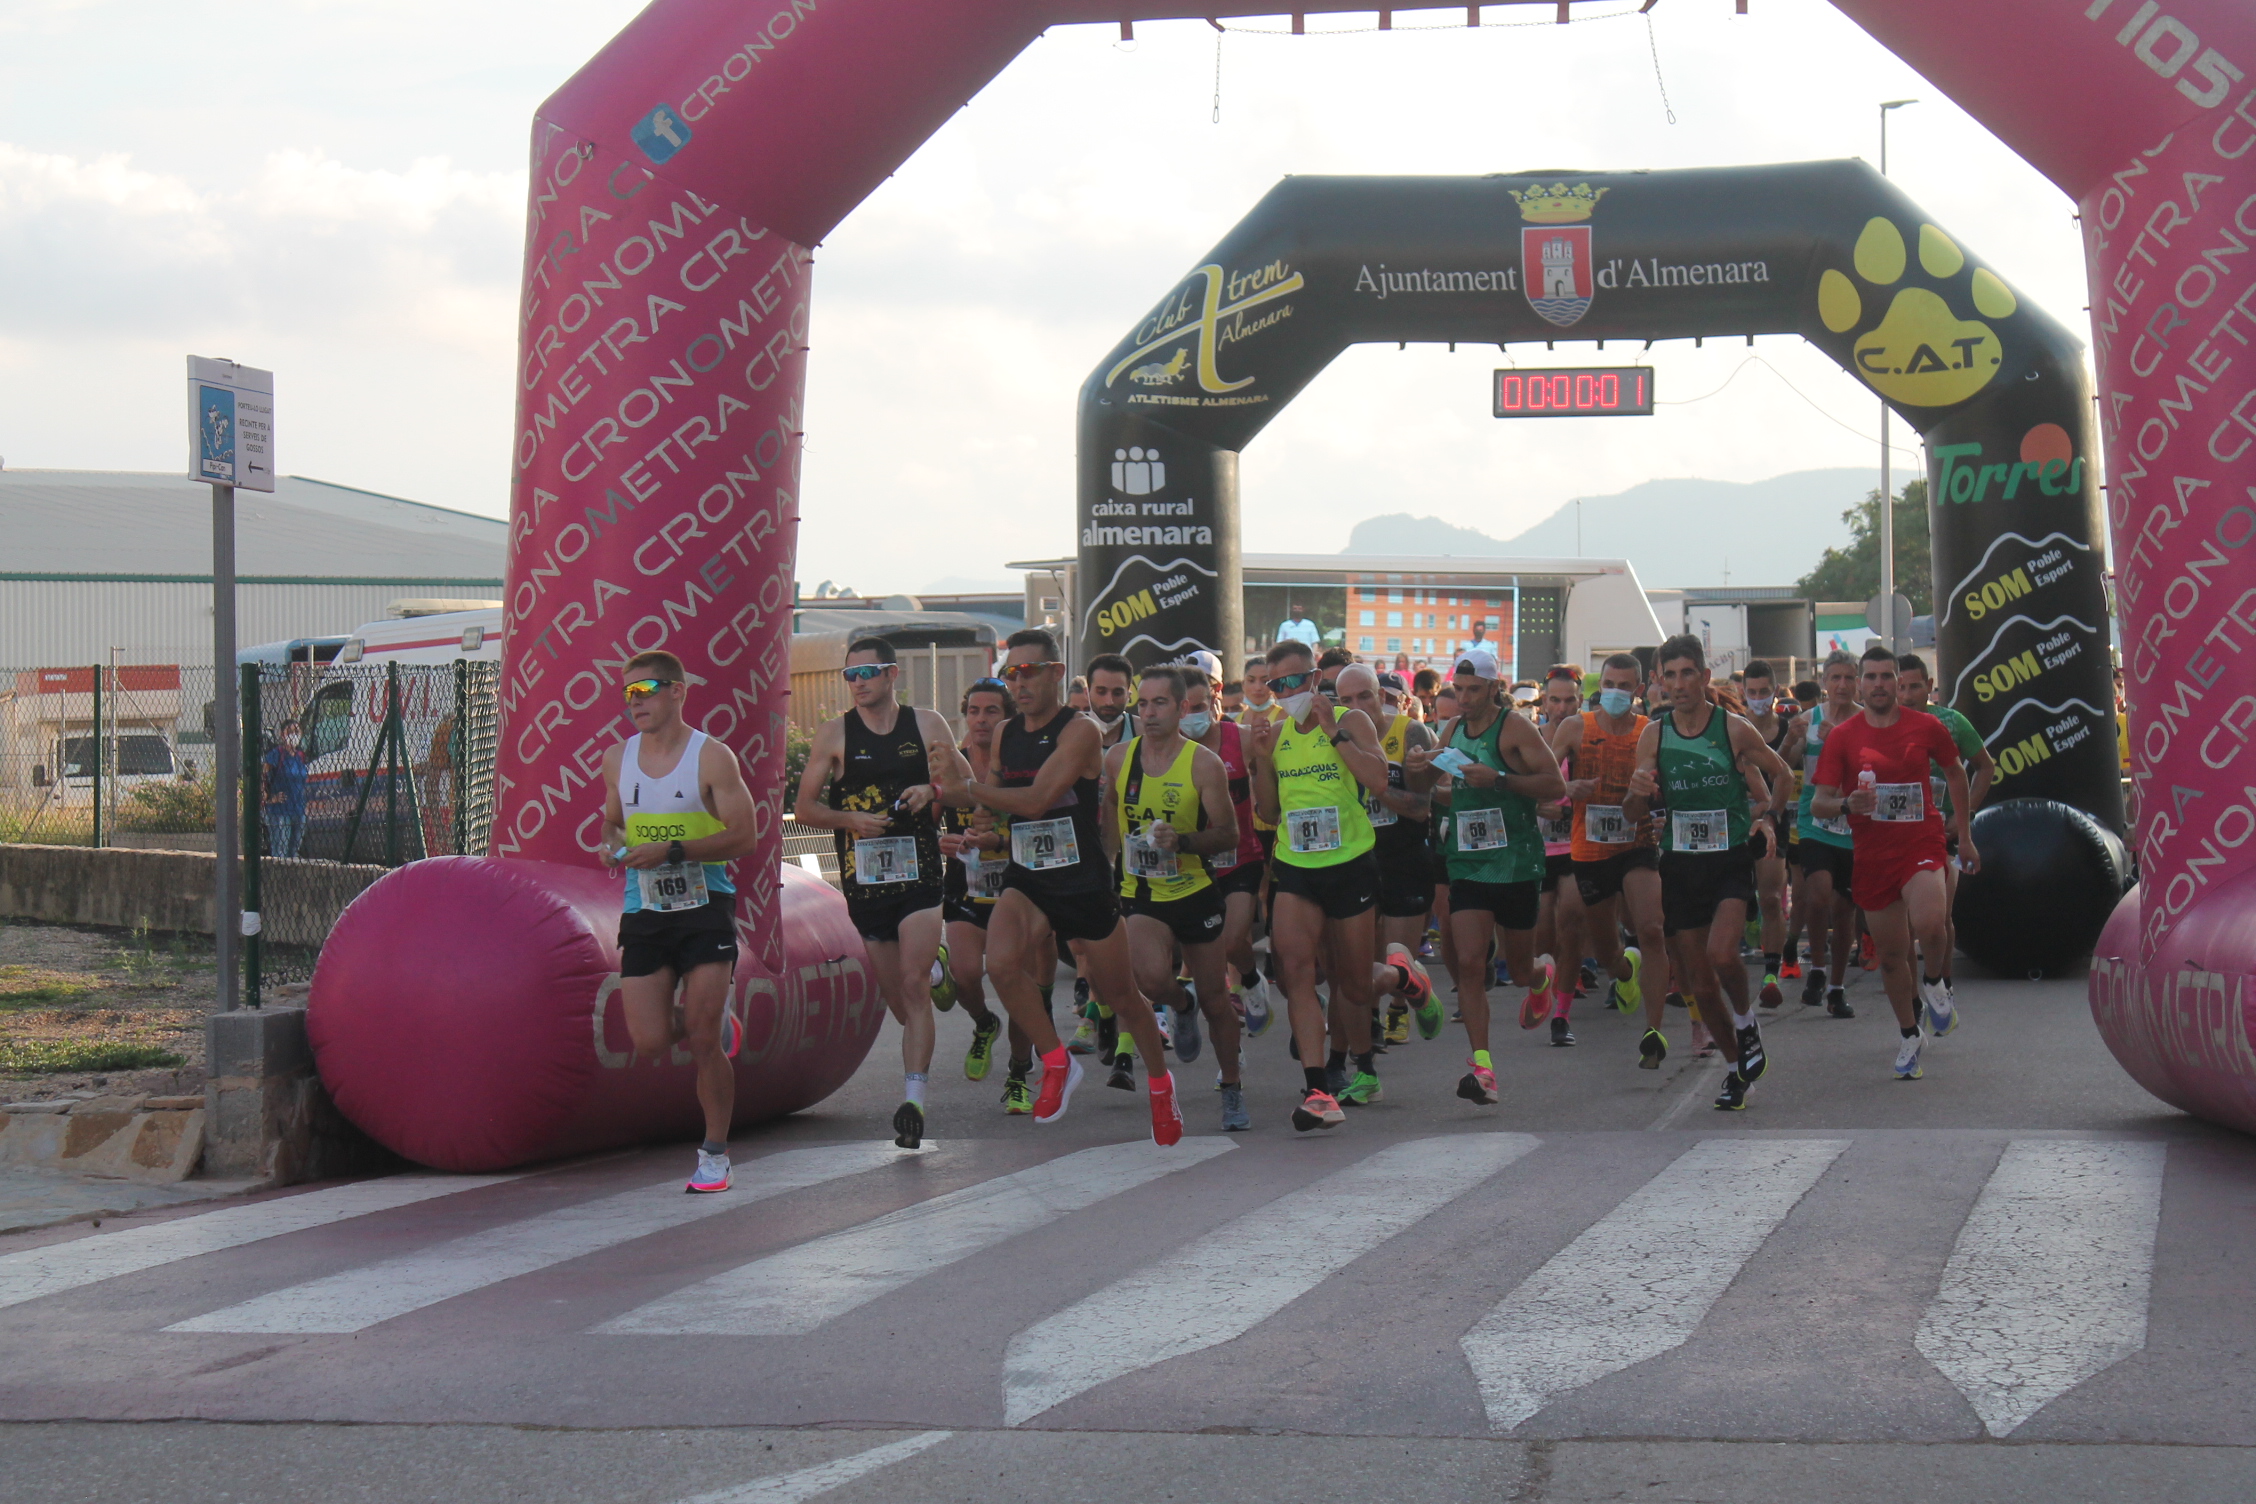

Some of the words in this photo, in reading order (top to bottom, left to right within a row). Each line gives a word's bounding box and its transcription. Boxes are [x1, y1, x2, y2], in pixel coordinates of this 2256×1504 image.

[1354, 264, 1517, 299] Ajuntament
[1596, 259, 1769, 290] d'Almenara
[1135, 286, 1192, 345] Club
[1218, 304, 1293, 351] Almenara
[1127, 394, 1199, 406] ATLETISME
[1202, 394, 1269, 406] ALMENARA
[1933, 442, 2085, 505] Torres
[1091, 498, 1136, 516] caixa
[1142, 498, 1194, 516] rural
[1082, 520, 1212, 547] almenara
[2027, 548, 2062, 573] Poble
[1152, 572, 1188, 595] Poble
[1964, 566, 2032, 620] SOM
[2034, 560, 2074, 587] Esport
[1097, 588, 1158, 637] SOM
[1159, 584, 1199, 609] Esport
[2036, 630, 2070, 655] Poble
[1973, 649, 2042, 702] SOM
[2043, 642, 2082, 670] Esport
[2046, 713, 2080, 739] Poble
[2053, 725, 2091, 753] Esport
[1889, 795, 1907, 809] 32
[636, 824, 686, 841] saggas
[1302, 821, 1319, 838] 81
[1469, 822, 1487, 837] 58
[1601, 818, 1622, 831] 161
[1690, 823, 1708, 838] 39
[1033, 835, 1054, 853] 20
[878, 850, 893, 868] 17
[1137, 850, 1159, 867] 119
[655, 877, 688, 897] 169
